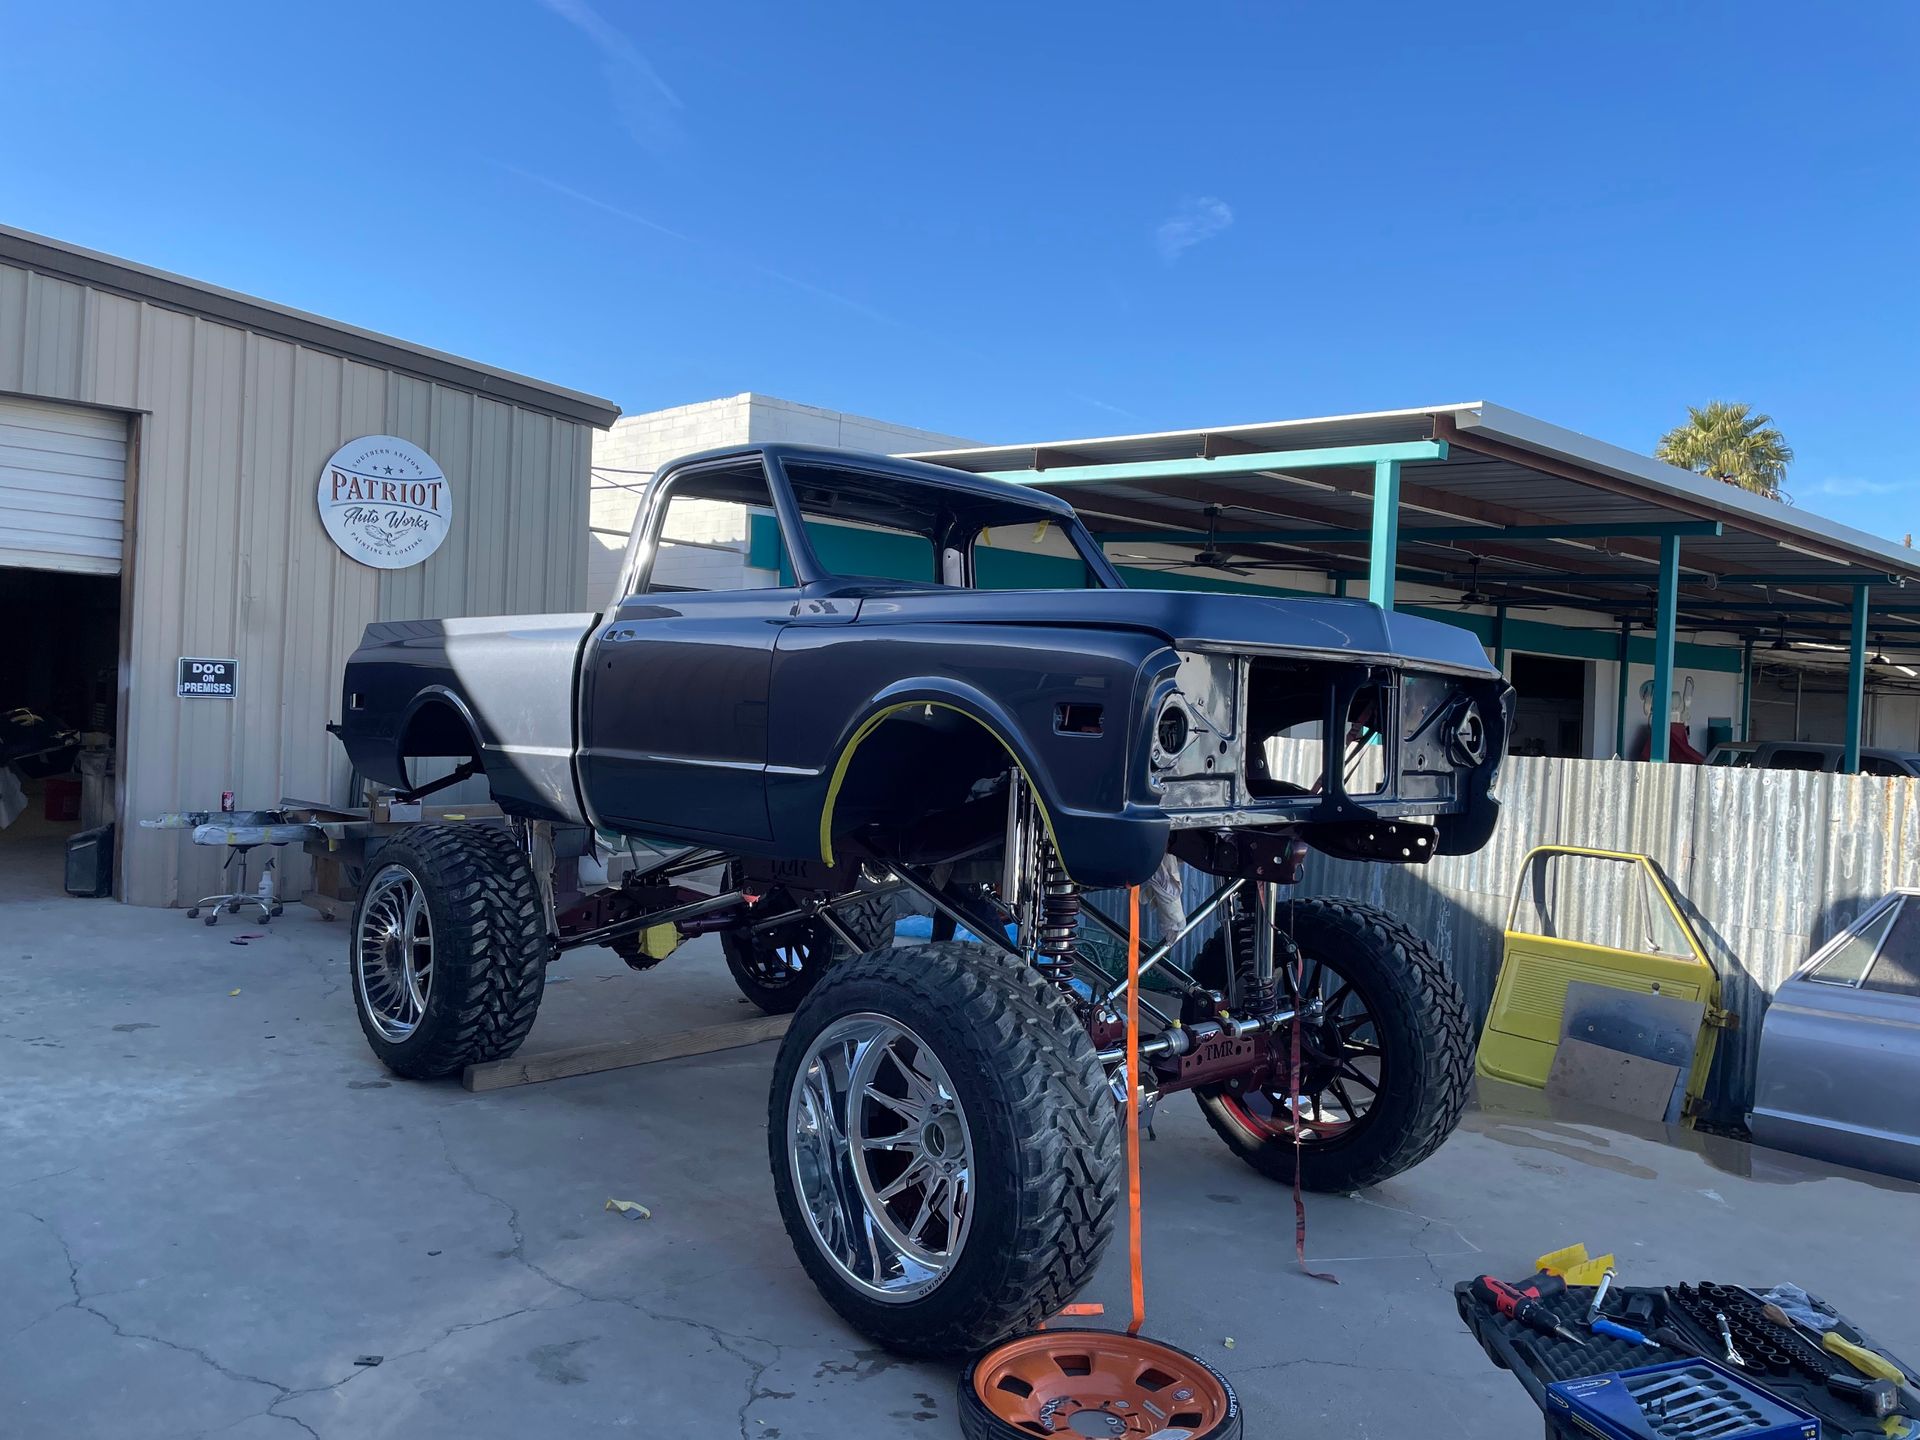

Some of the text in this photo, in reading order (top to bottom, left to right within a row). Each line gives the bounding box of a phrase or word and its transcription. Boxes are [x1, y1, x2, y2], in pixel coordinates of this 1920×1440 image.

[331, 470, 442, 511] PATRIOT
[343, 506, 430, 531] Auto Works
[192, 663, 225, 674] DOG
[202, 674, 215, 682] ON
[184, 682, 232, 693] PREMISES
[1205, 1040, 1234, 1061] TMR
[919, 1265, 951, 1296] FORGIATO
